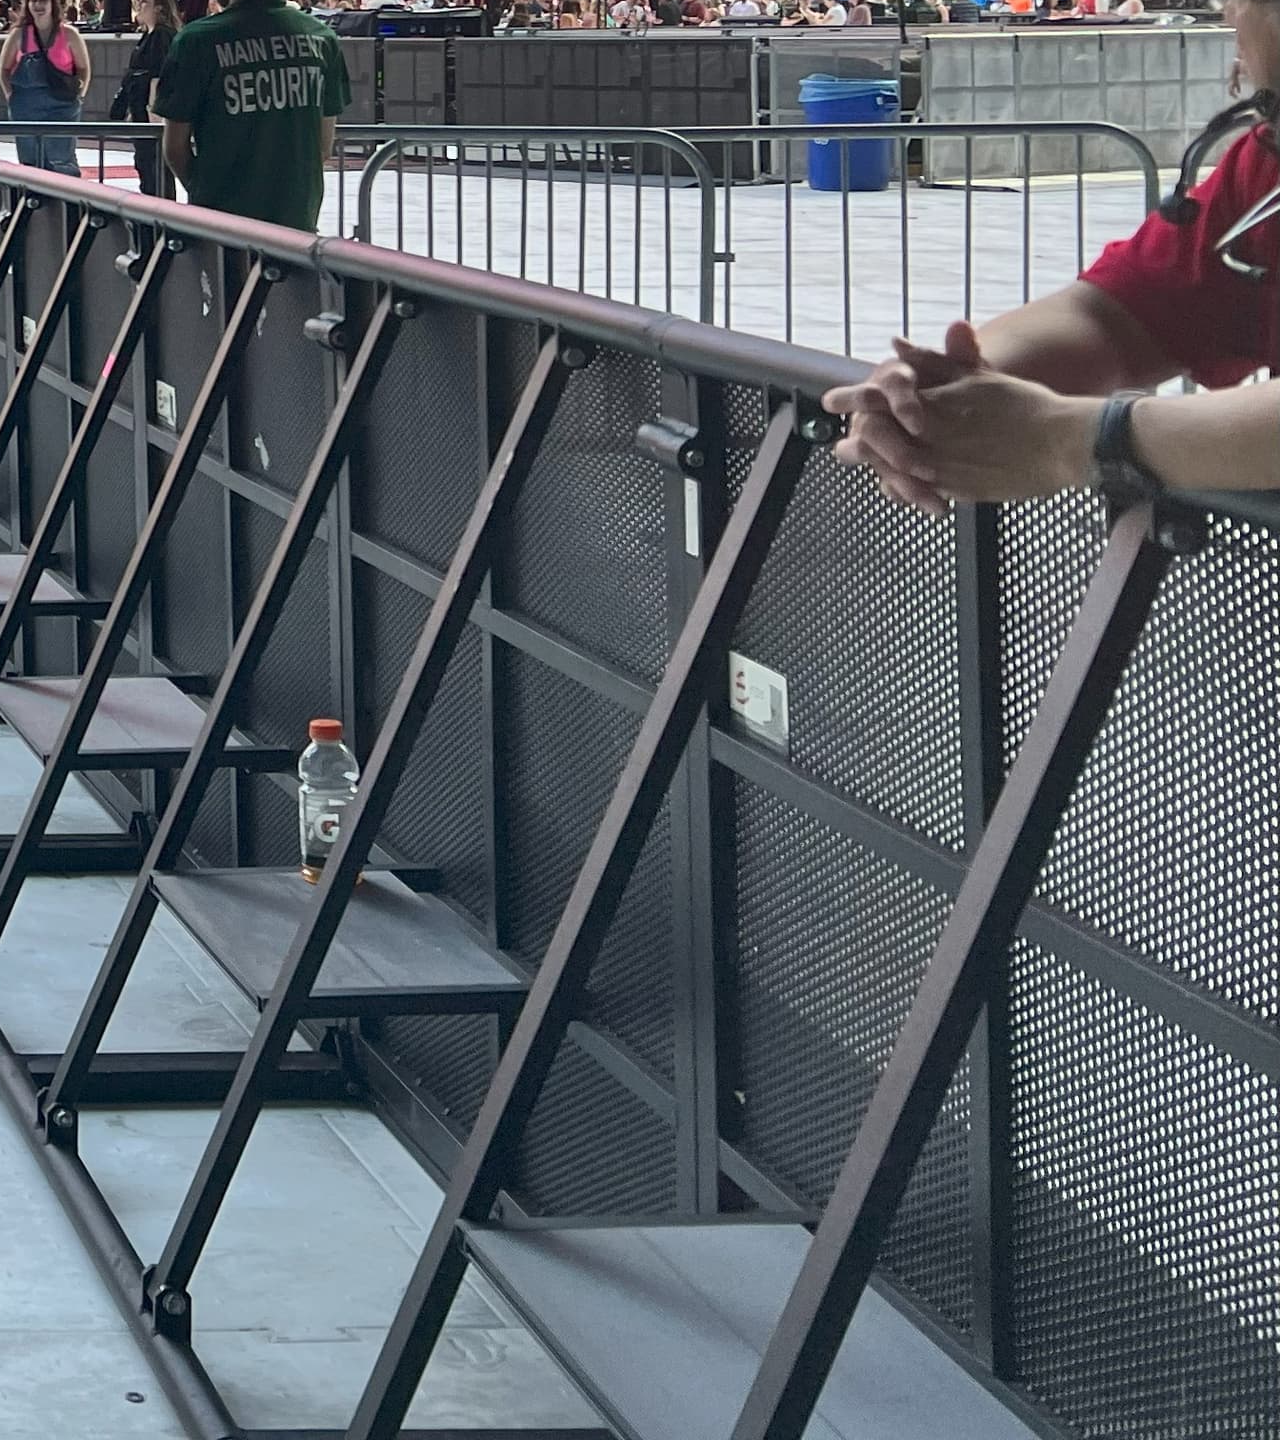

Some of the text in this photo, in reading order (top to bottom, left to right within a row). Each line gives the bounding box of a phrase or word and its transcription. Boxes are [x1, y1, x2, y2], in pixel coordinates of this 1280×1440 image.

[215, 33, 325, 68] MAIN EVENT
[223, 65, 325, 116] SECURITY
[314, 813, 340, 843] G
